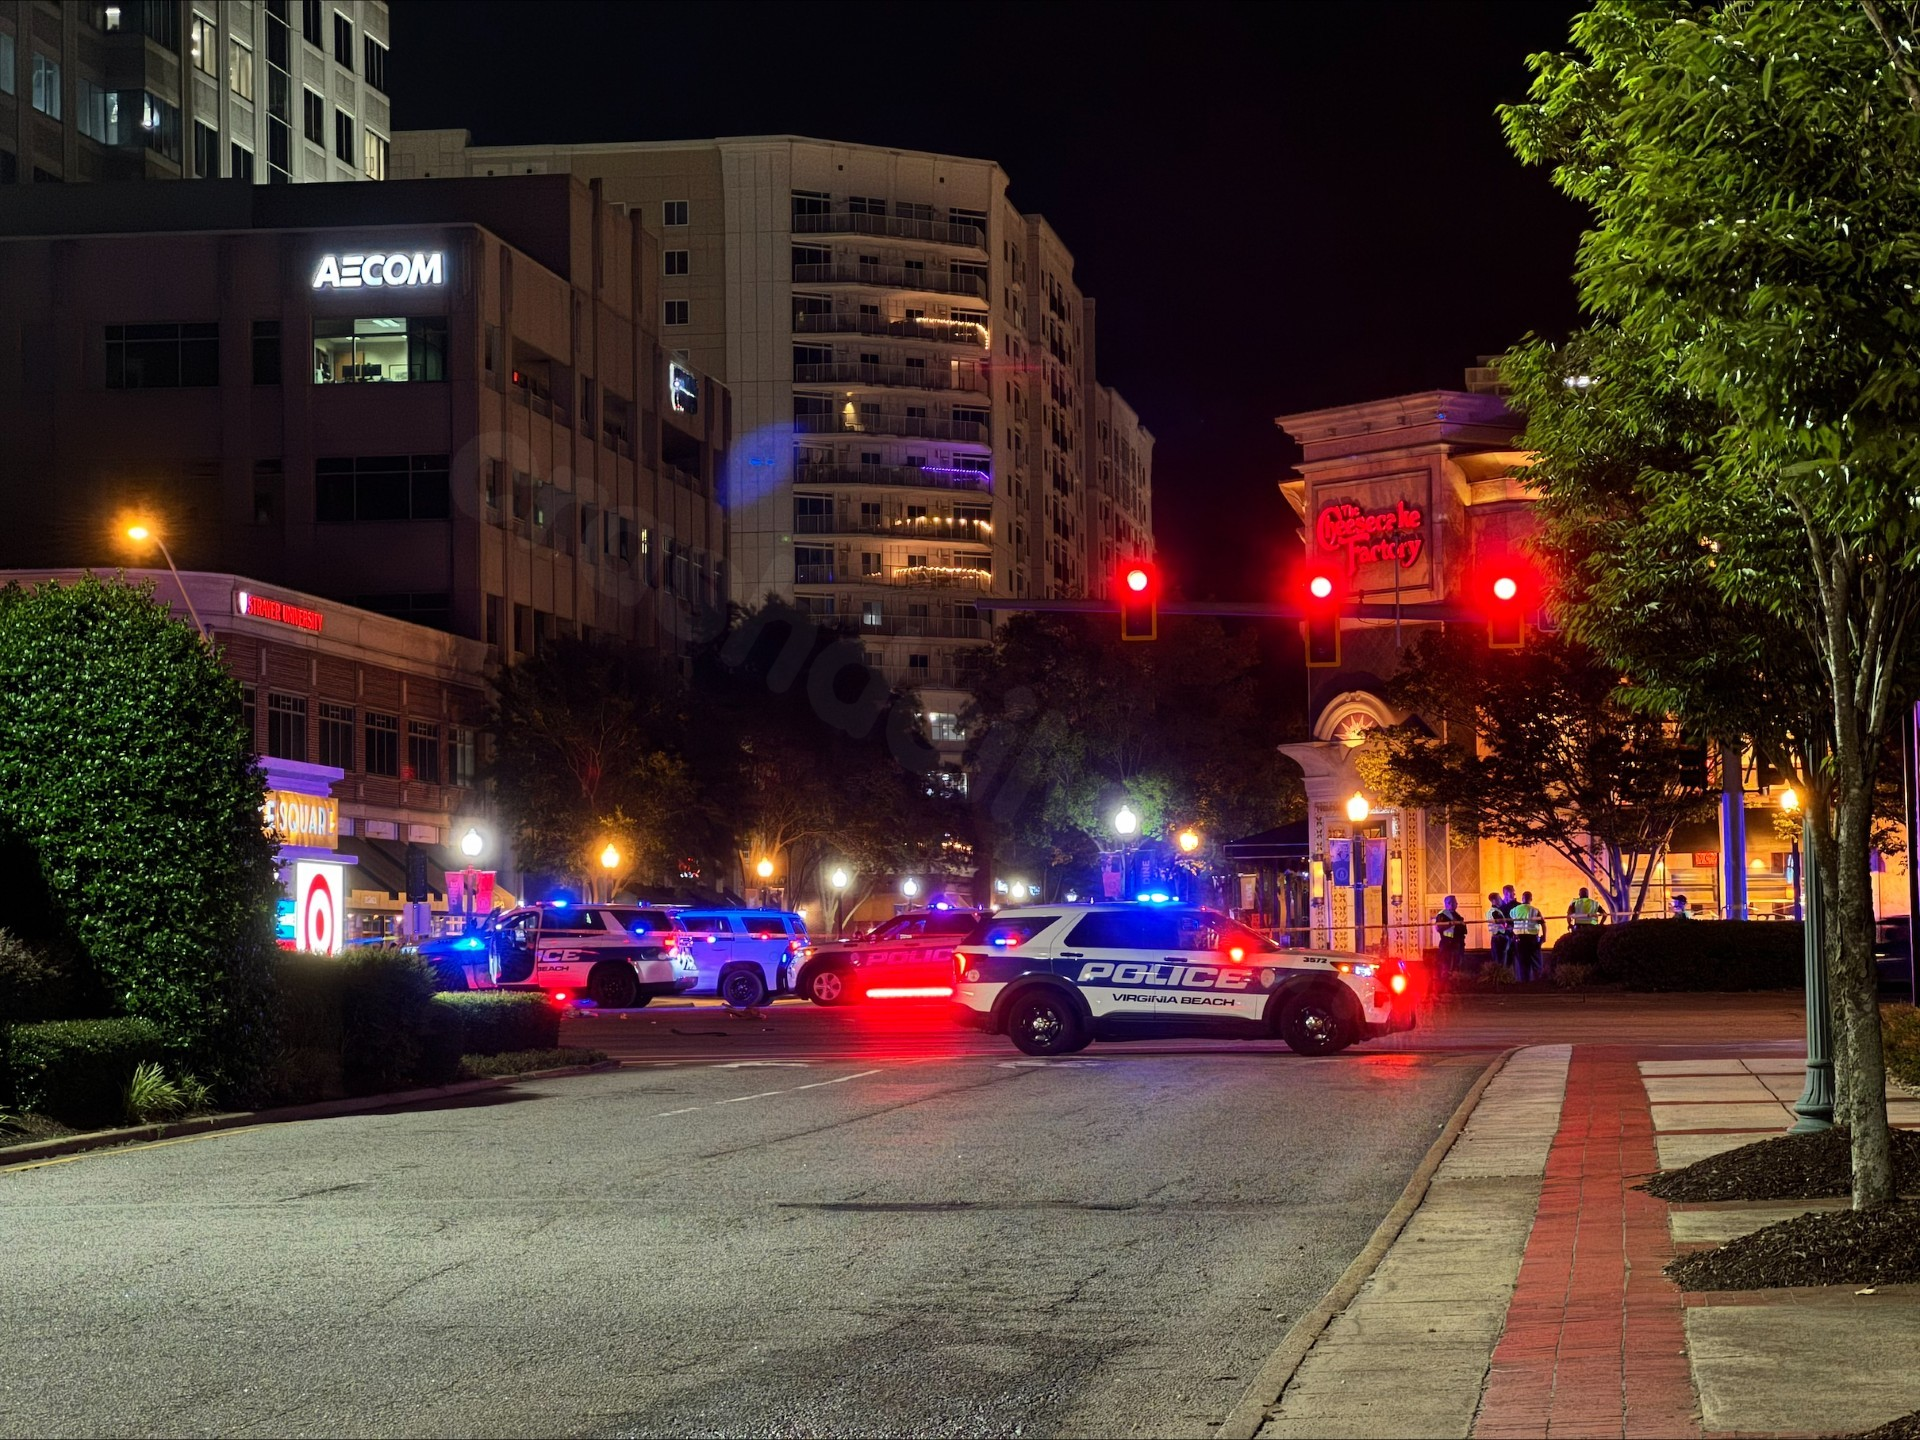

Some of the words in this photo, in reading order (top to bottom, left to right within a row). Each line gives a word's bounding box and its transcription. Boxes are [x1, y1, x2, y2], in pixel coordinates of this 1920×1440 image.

[313, 252, 442, 288] AECOM
[1341, 504, 1360, 517] The
[1317, 500, 1421, 551] Cheesecake
[1338, 533, 1421, 576] Factory
[248, 595, 281, 621] STRAYER
[282, 604, 323, 631] UNIVERSITY
[1142, 860, 1151, 885] DINE
[866, 948, 953, 966] POLIC
[1077, 961, 1252, 990] POLICE
[1112, 993, 1178, 1005] VIRGINIA
[1180, 997, 1236, 1007] BEACH
